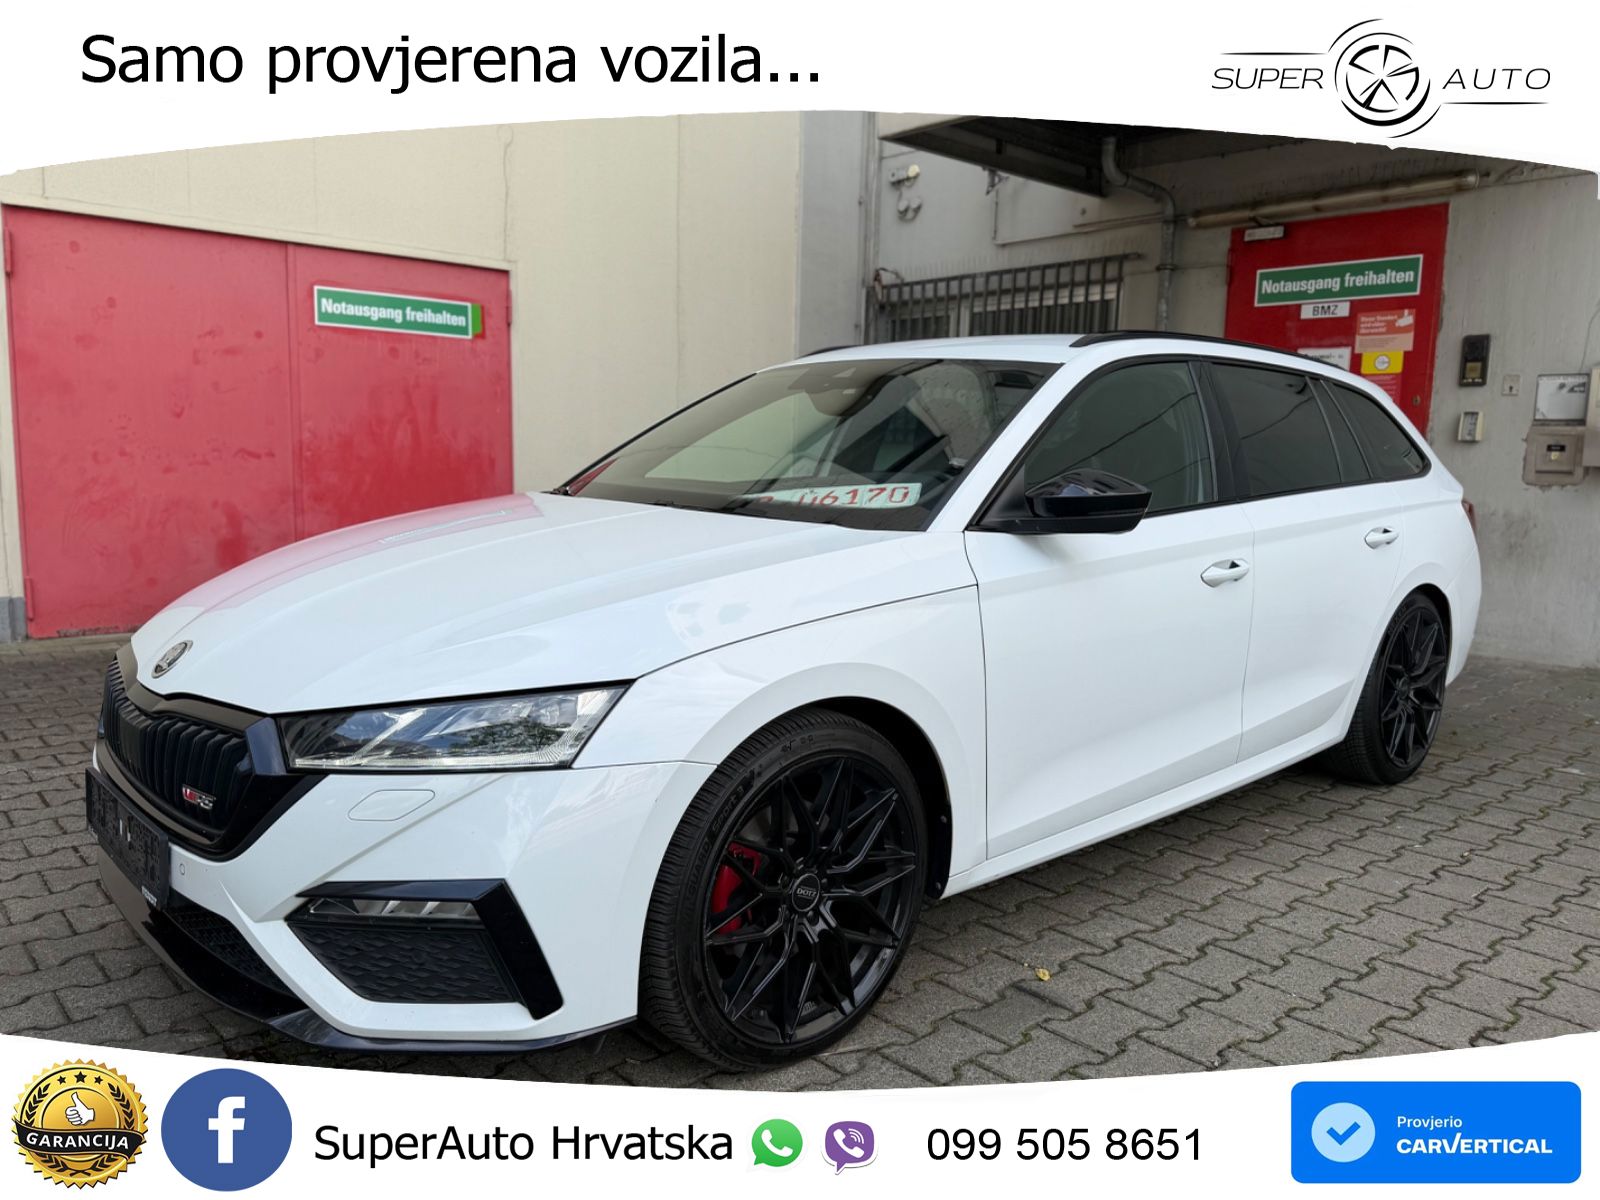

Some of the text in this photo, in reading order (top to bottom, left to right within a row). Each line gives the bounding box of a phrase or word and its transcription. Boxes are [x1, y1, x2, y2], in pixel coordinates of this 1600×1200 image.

[1261, 269, 1414, 295] Notausgang freihalten
[320, 297, 466, 327] Notausgang freihalten
[1312, 304, 1339, 317] BMZ
[796, 888, 817, 897] DOTZ
